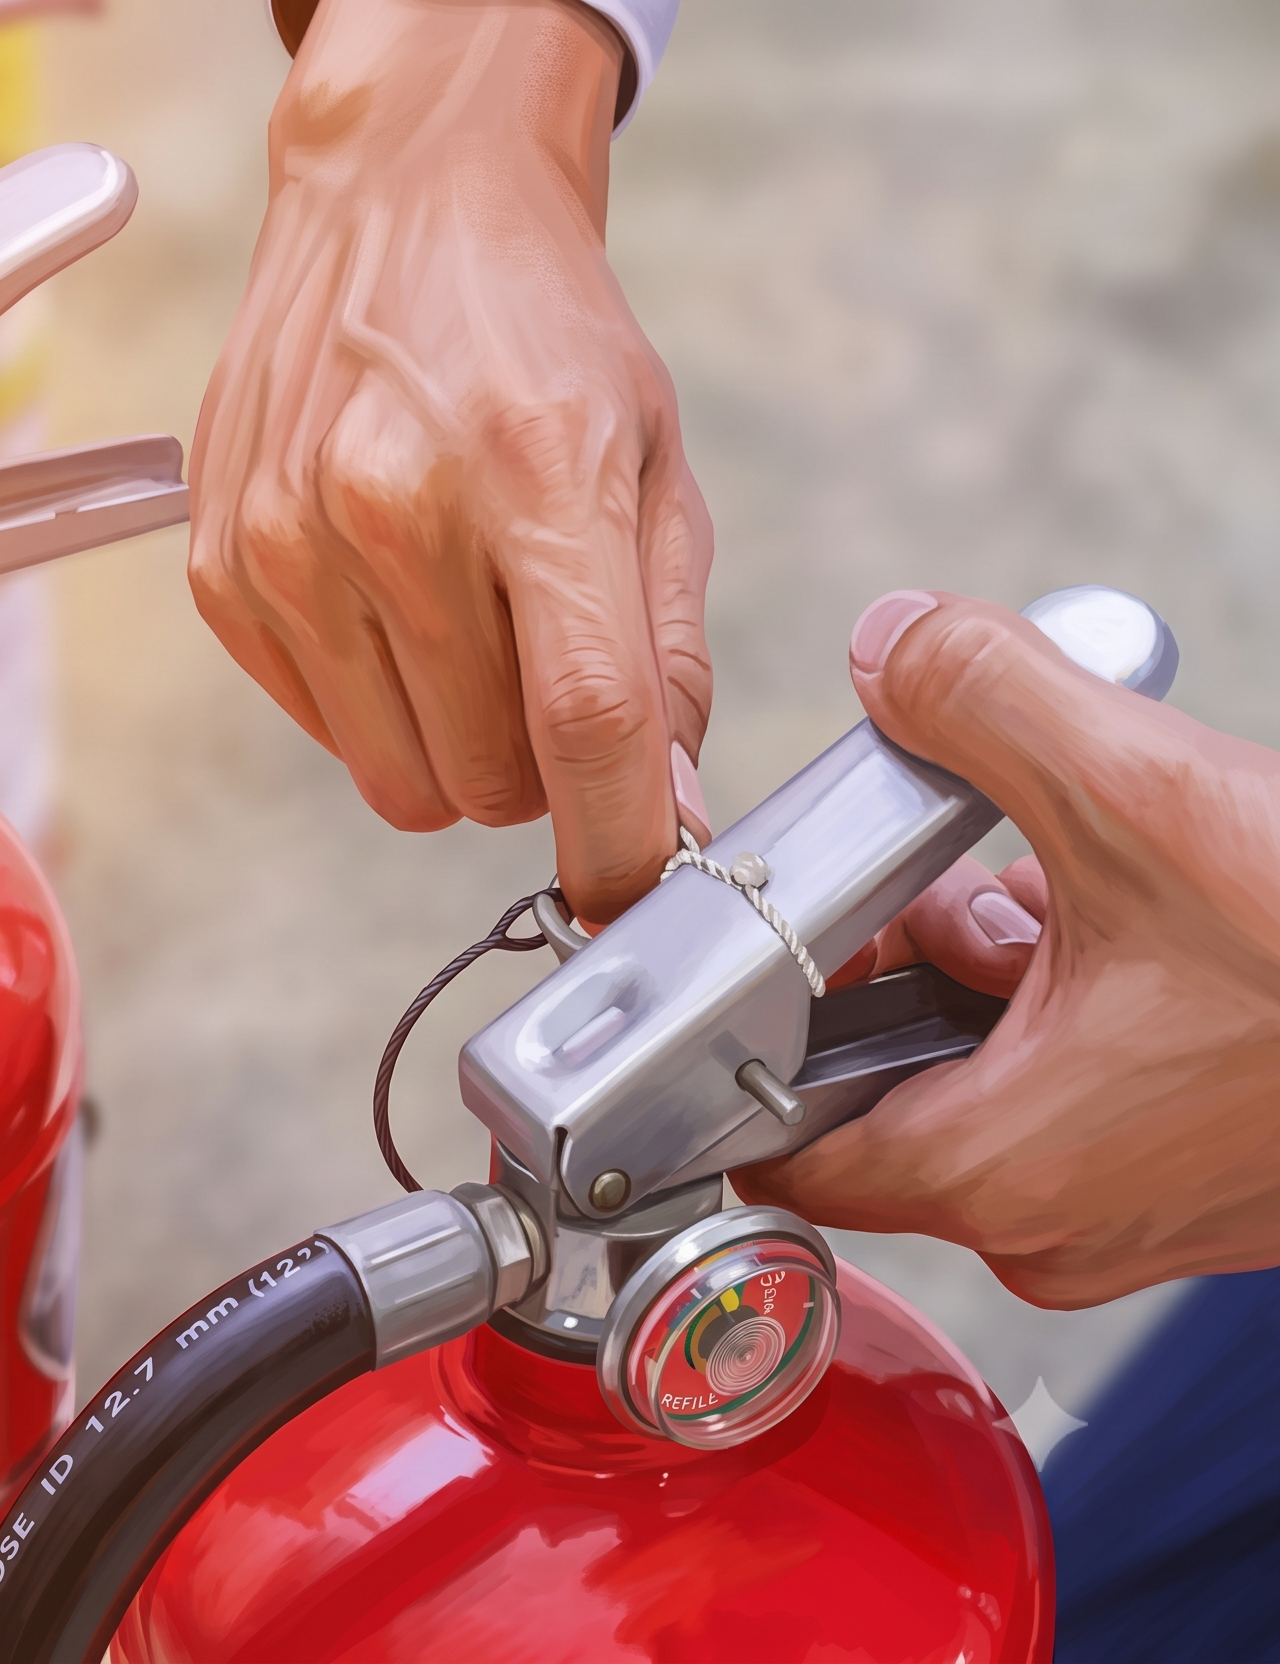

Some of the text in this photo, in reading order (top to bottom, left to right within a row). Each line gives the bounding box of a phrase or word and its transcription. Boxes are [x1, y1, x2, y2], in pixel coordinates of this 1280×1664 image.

[40, 1454, 74, 1496] ID
[85, 1356, 154, 1434] 12.7
[175, 1296, 239, 1350] mm
